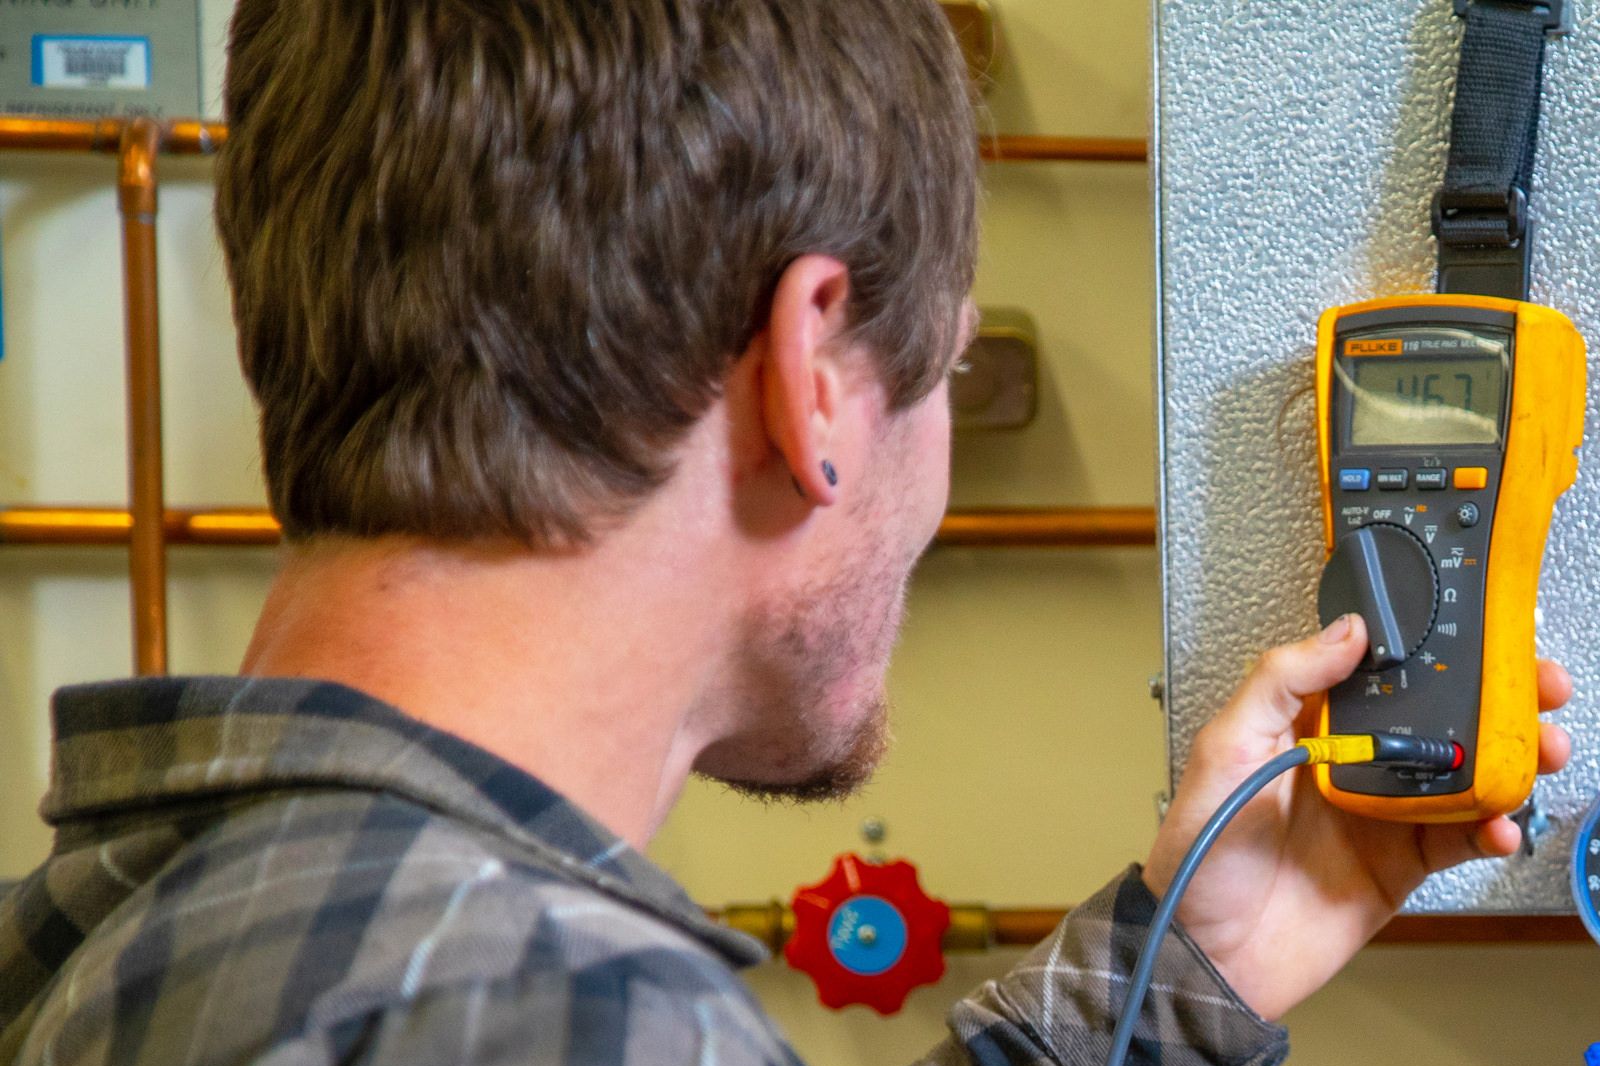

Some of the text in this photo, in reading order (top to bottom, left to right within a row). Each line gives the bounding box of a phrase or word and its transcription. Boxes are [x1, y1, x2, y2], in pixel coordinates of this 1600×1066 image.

[1350, 342, 1398, 352] FLUKE
[1341, 506, 1370, 515] AUTO-V
[1373, 510, 1392, 519] OFF
[1441, 557, 1462, 568] mV
